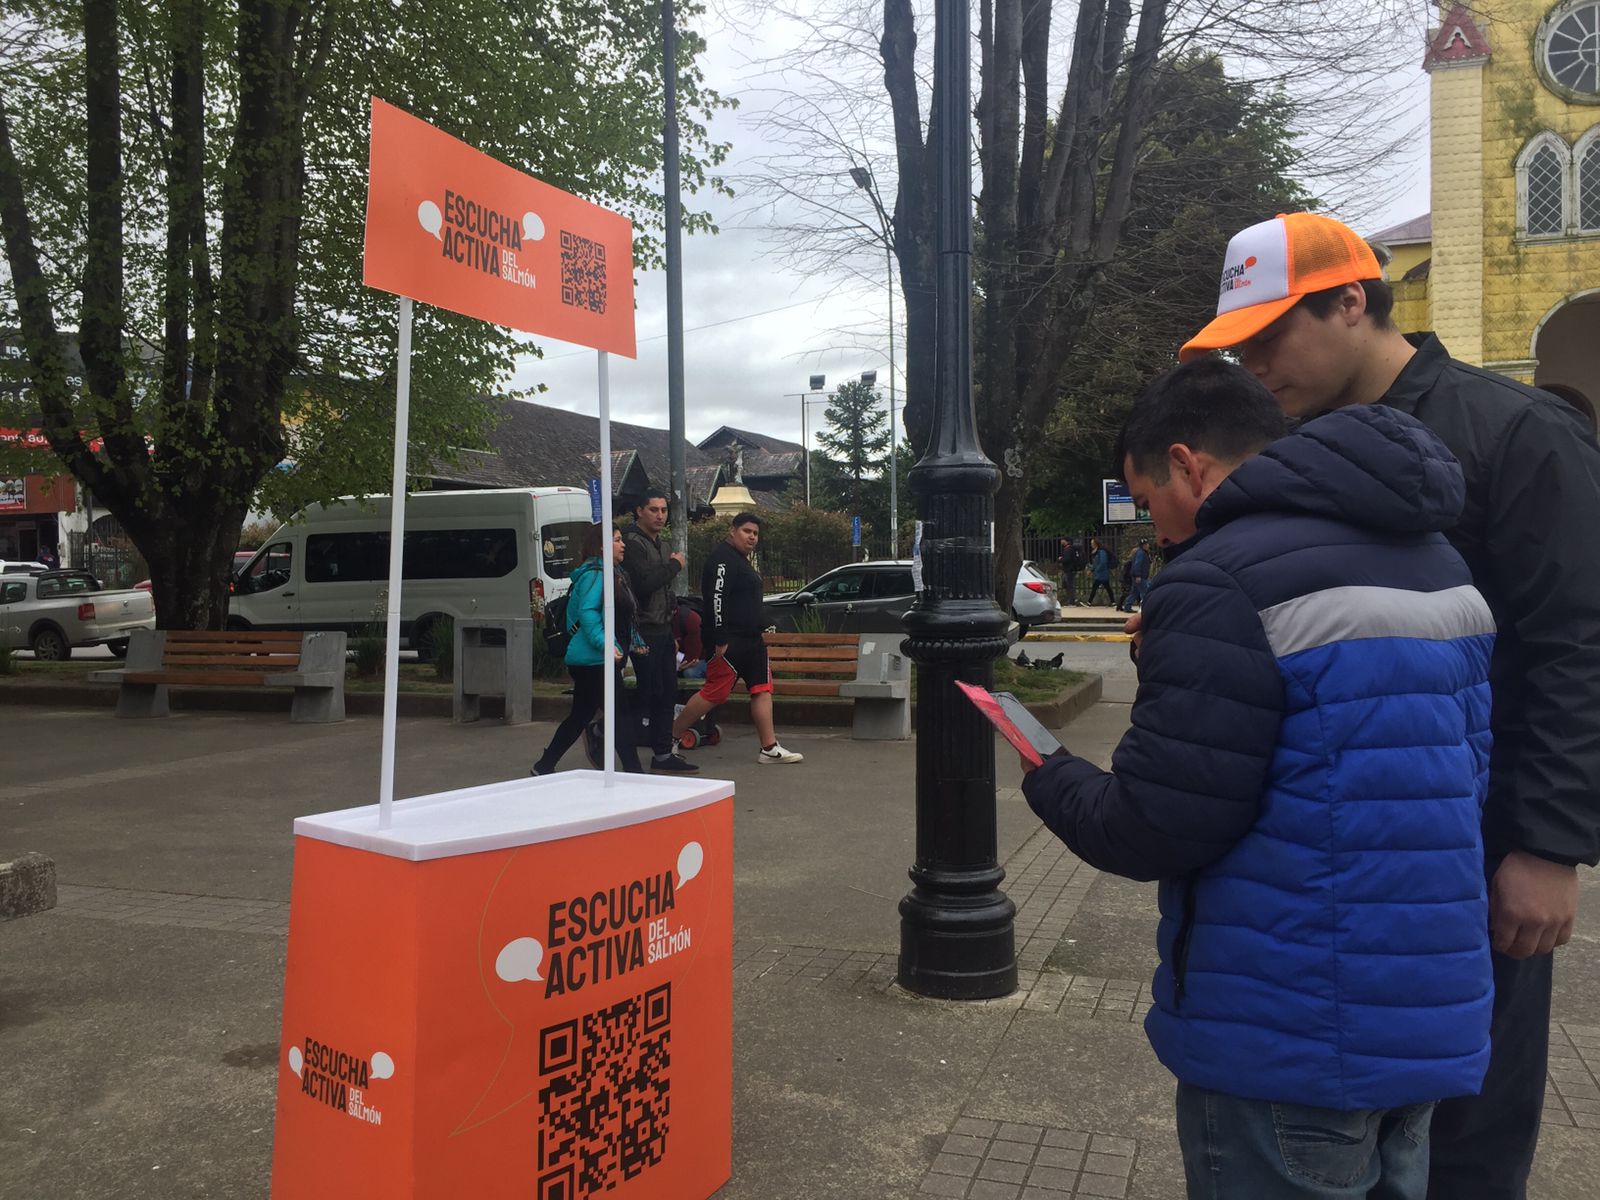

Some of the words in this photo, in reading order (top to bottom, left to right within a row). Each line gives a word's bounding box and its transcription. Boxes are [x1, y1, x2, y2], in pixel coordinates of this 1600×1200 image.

[445, 189, 522, 252] ESCUCHA
[442, 226, 500, 278] ACTIVA
[502, 249, 518, 268] DEL
[502, 266, 536, 289] SALMÓN
[548, 870, 675, 949] ESCUCHA
[648, 917, 670, 943] DEL
[544, 926, 645, 1000] ACTIVA
[648, 924, 691, 965] SALMÓN
[304, 1036, 369, 1090] ESCUCHA
[302, 1068, 347, 1113] ACTIVA
[349, 1087, 364, 1106] DEL
[348, 1101, 382, 1126] SALMÓN
